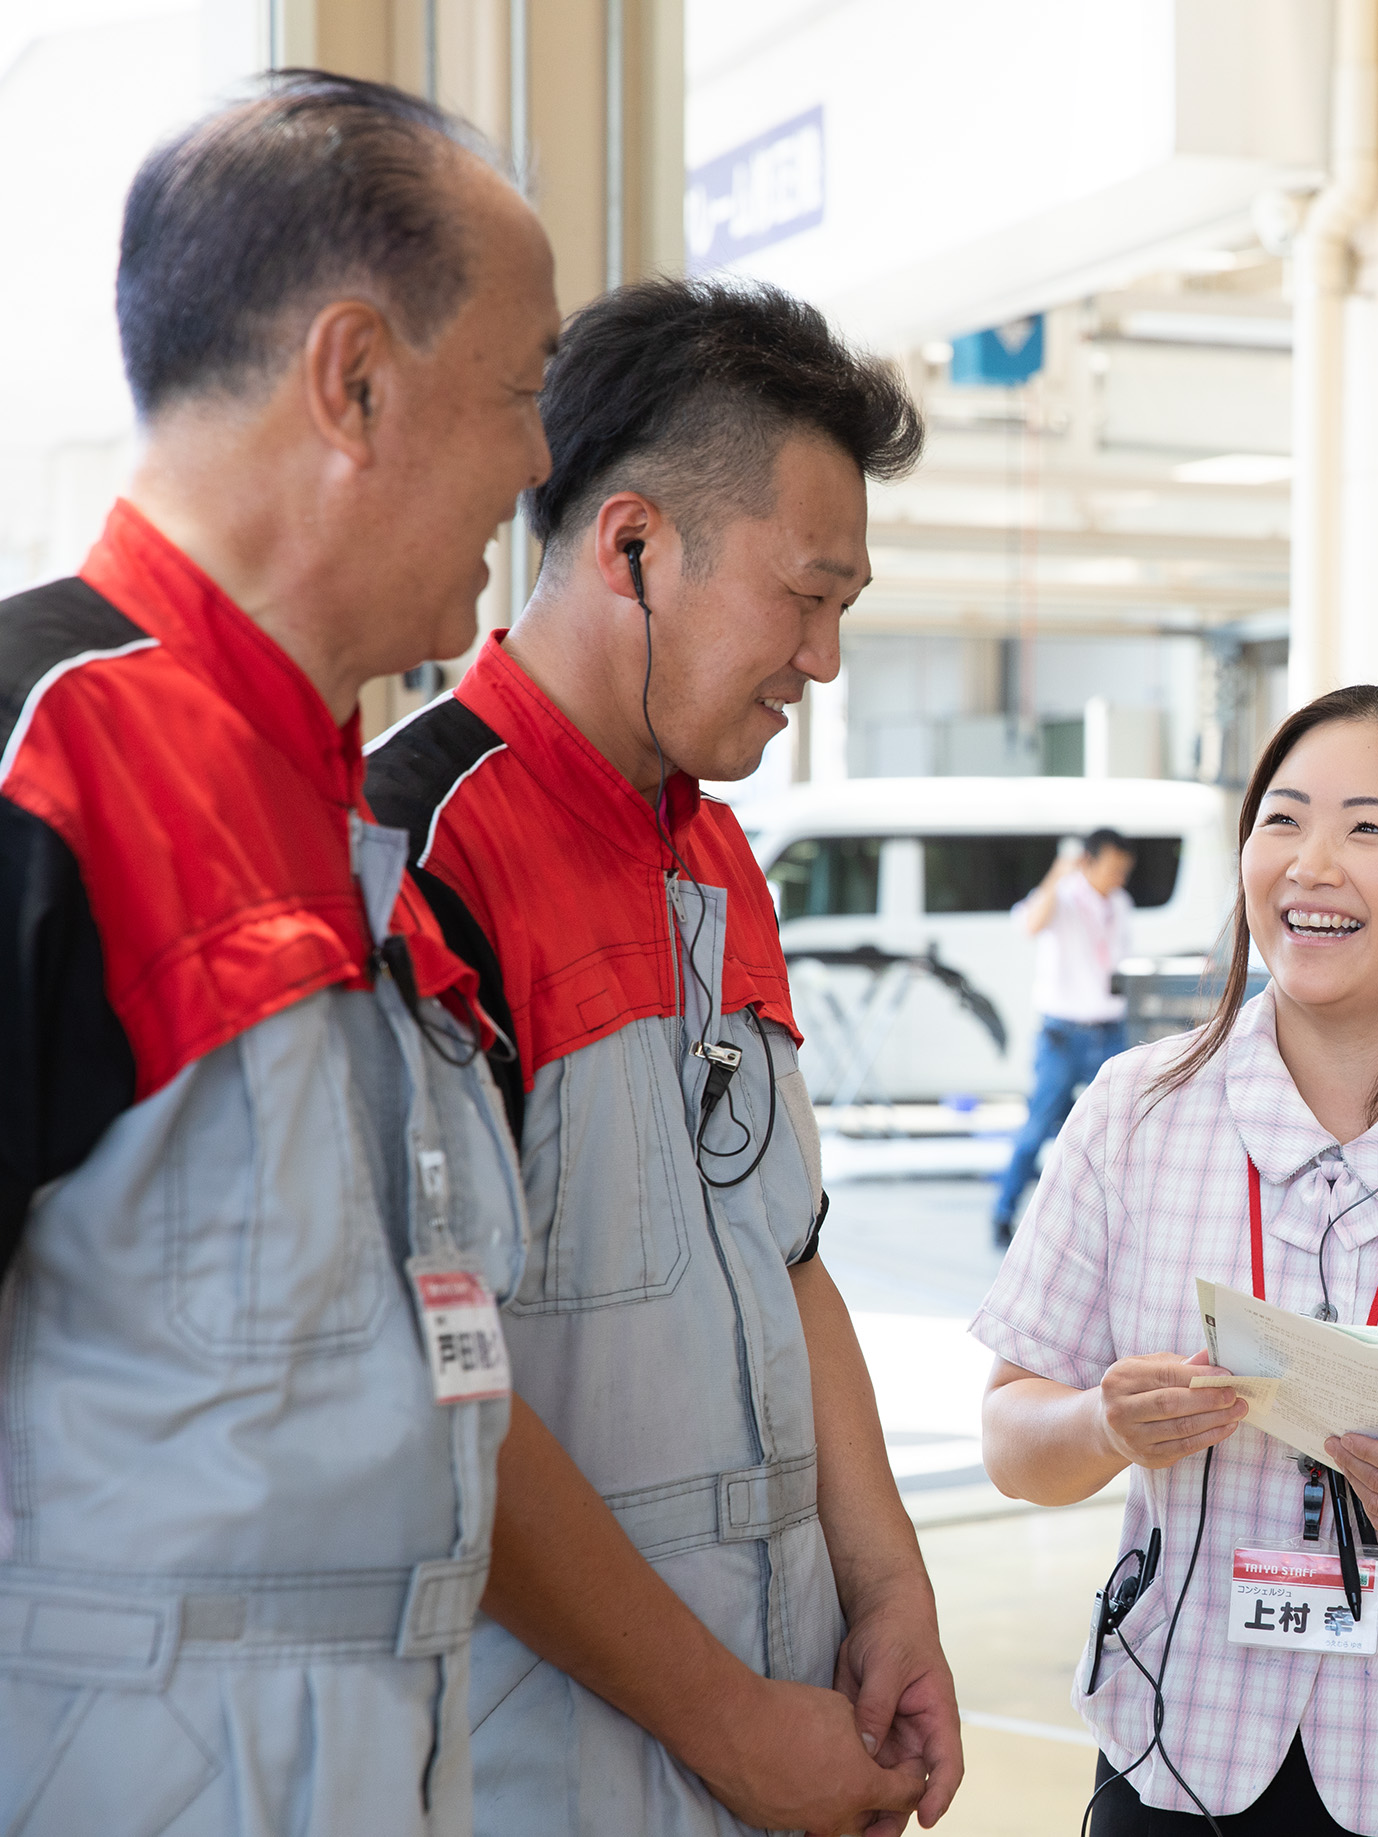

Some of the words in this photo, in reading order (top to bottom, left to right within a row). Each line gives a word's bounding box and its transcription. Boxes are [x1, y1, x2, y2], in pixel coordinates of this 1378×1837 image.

[1245, 1563, 1278, 1574] TAIYO
[1281, 1566, 1317, 1577] STAFF
[1237, 1585, 1292, 1597] コンシェルジュ
[1244, 1599, 1311, 1634] 上村
